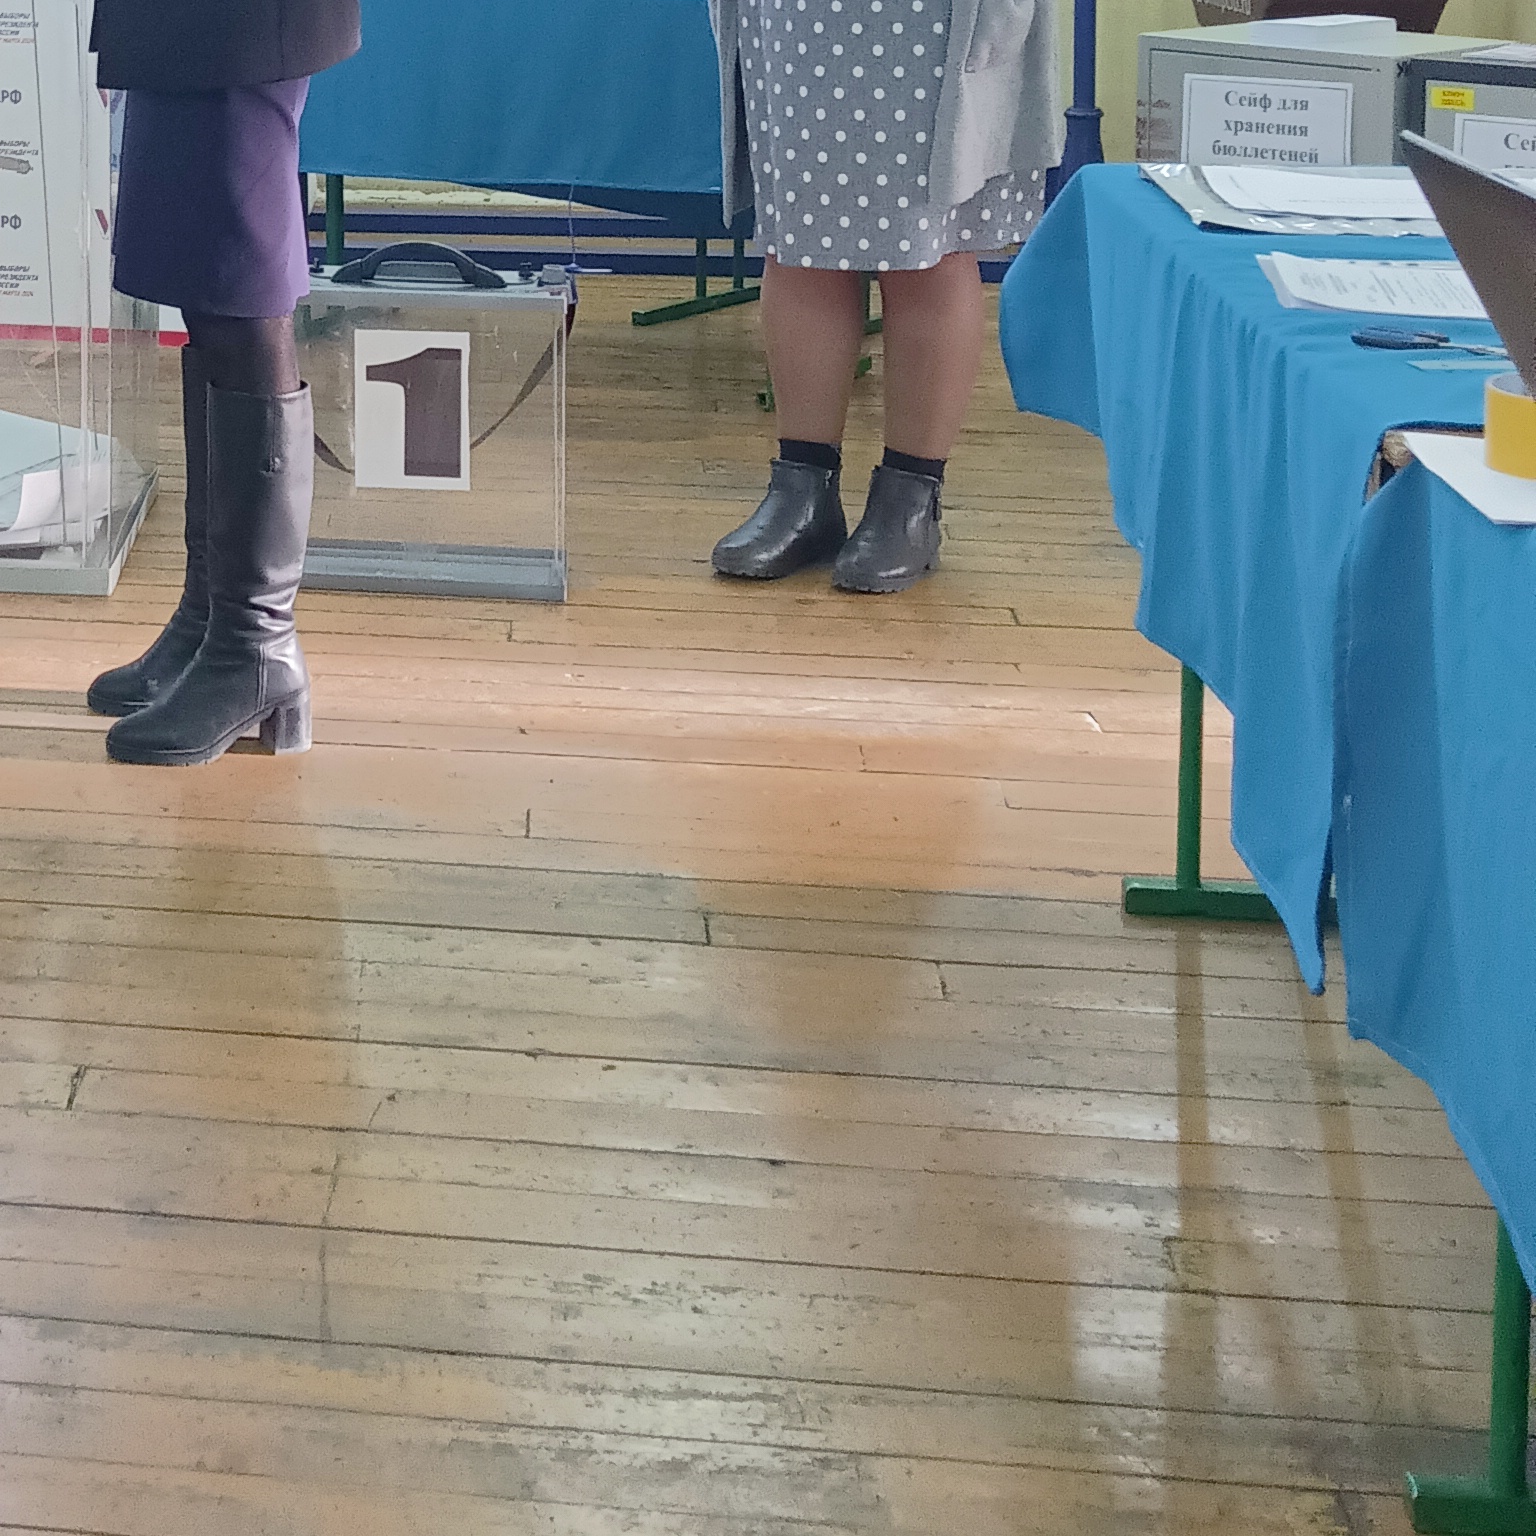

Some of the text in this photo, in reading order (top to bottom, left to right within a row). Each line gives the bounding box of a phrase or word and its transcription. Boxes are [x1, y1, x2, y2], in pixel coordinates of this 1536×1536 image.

[1224, 90, 1309, 112] Сейф для
[1224, 119, 1309, 137] хранения
[1211, 139, 1319, 164] бюллетеней
[365, 347, 462, 478] 1
